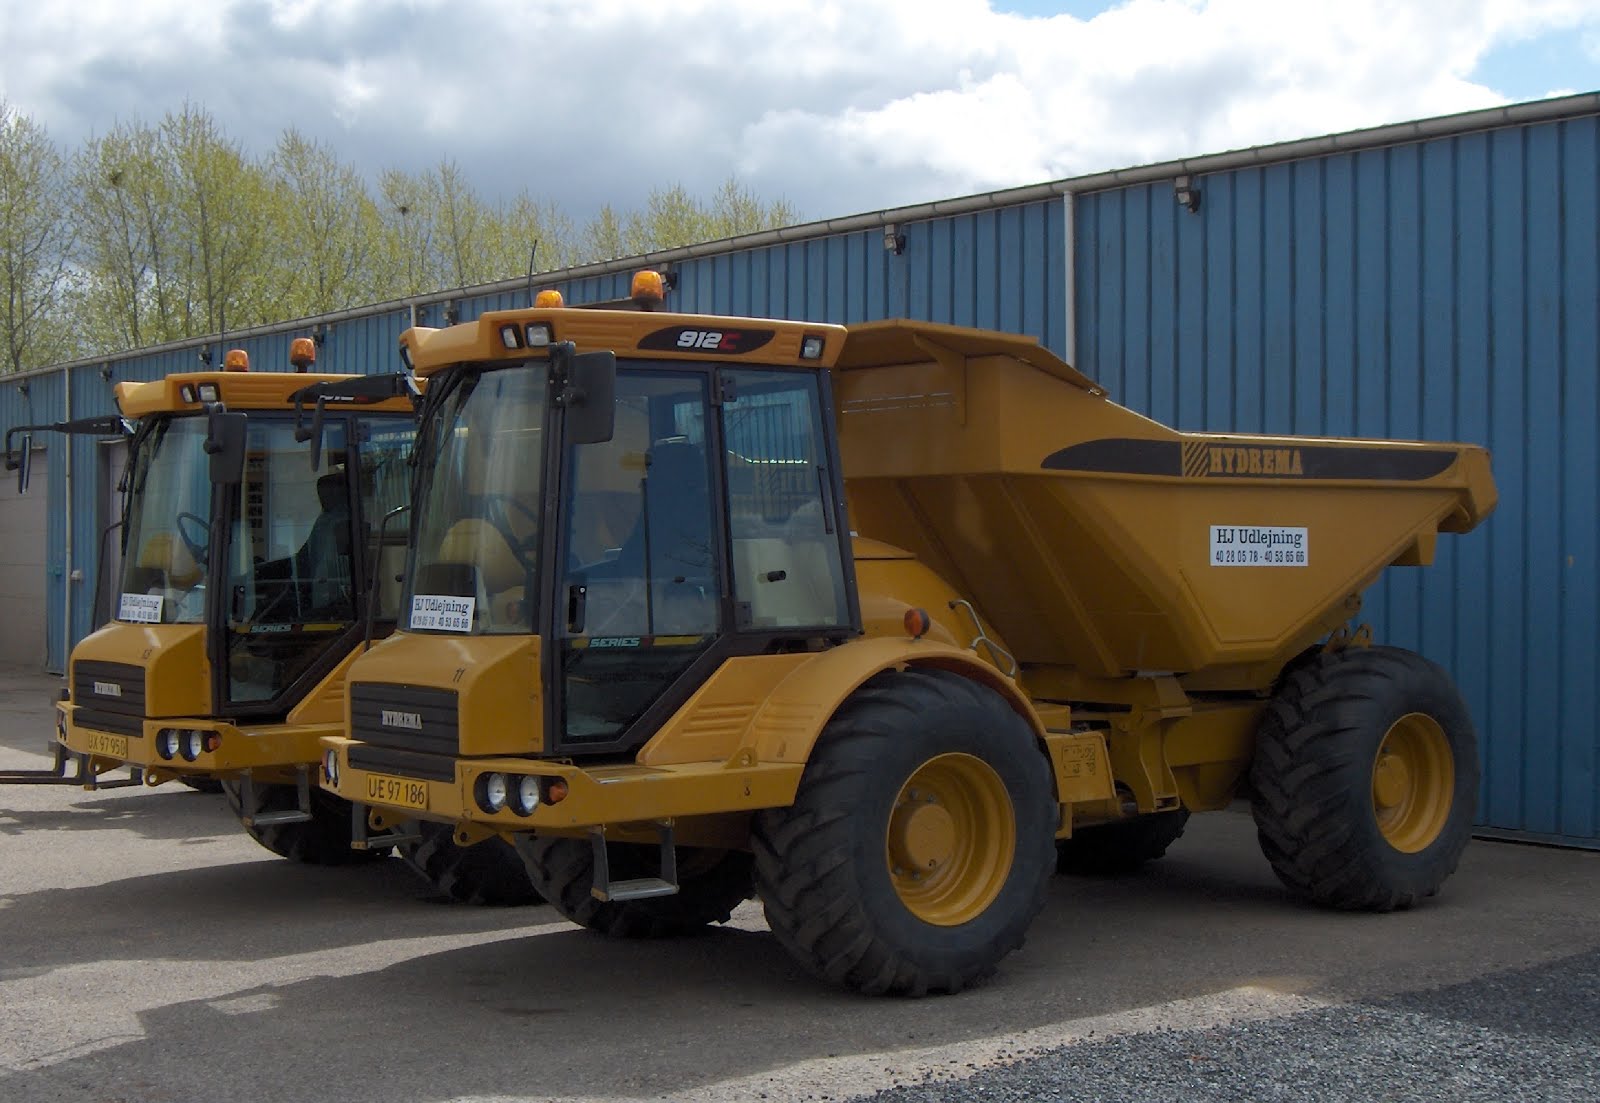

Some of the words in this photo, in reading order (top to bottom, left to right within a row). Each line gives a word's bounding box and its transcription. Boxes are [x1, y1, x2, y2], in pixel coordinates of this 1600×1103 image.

[676, 330, 741, 351] 912C
[1208, 447, 1303, 475] HYDREMA
[1216, 528, 1235, 544] HJ
[1238, 528, 1303, 549] Udlejning
[1215, 550, 1224, 562] 40
[1226, 550, 1235, 562] 28
[1237, 550, 1247, 562] 05
[1249, 550, 1258, 562] 78
[1264, 550, 1273, 563] 40
[1275, 550, 1284, 563] 53
[1285, 550, 1294, 563] 65
[1295, 550, 1305, 563] 66
[425, 599, 469, 616] Udlejning
[589, 638, 641, 648] SERIES
[100, 736, 110, 752] 97
[368, 779, 385, 799] UE
[387, 780, 401, 801] 97
[404, 783, 425, 805] 186
